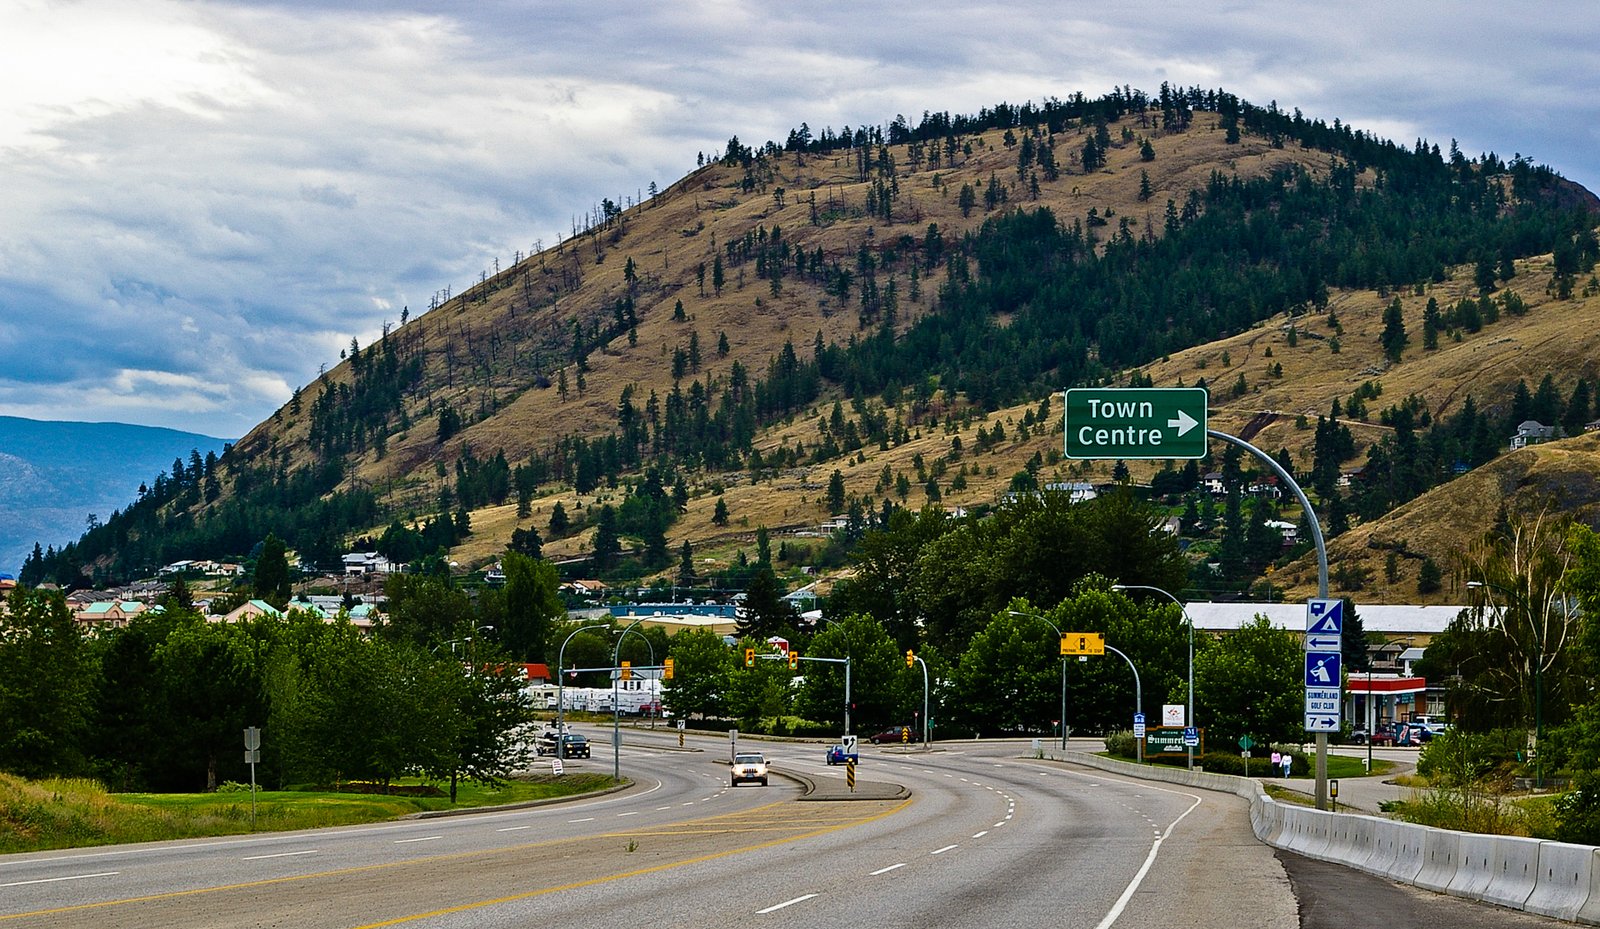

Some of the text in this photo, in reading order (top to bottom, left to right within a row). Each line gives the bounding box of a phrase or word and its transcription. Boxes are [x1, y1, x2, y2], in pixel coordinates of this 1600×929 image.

[1088, 399, 1153, 419] Town
[1078, 425, 1163, 446] Centre
[1307, 691, 1338, 699] SUMMERLAND
[1311, 702, 1334, 710] GOLF CLUB
[1309, 717, 1317, 727] 7
